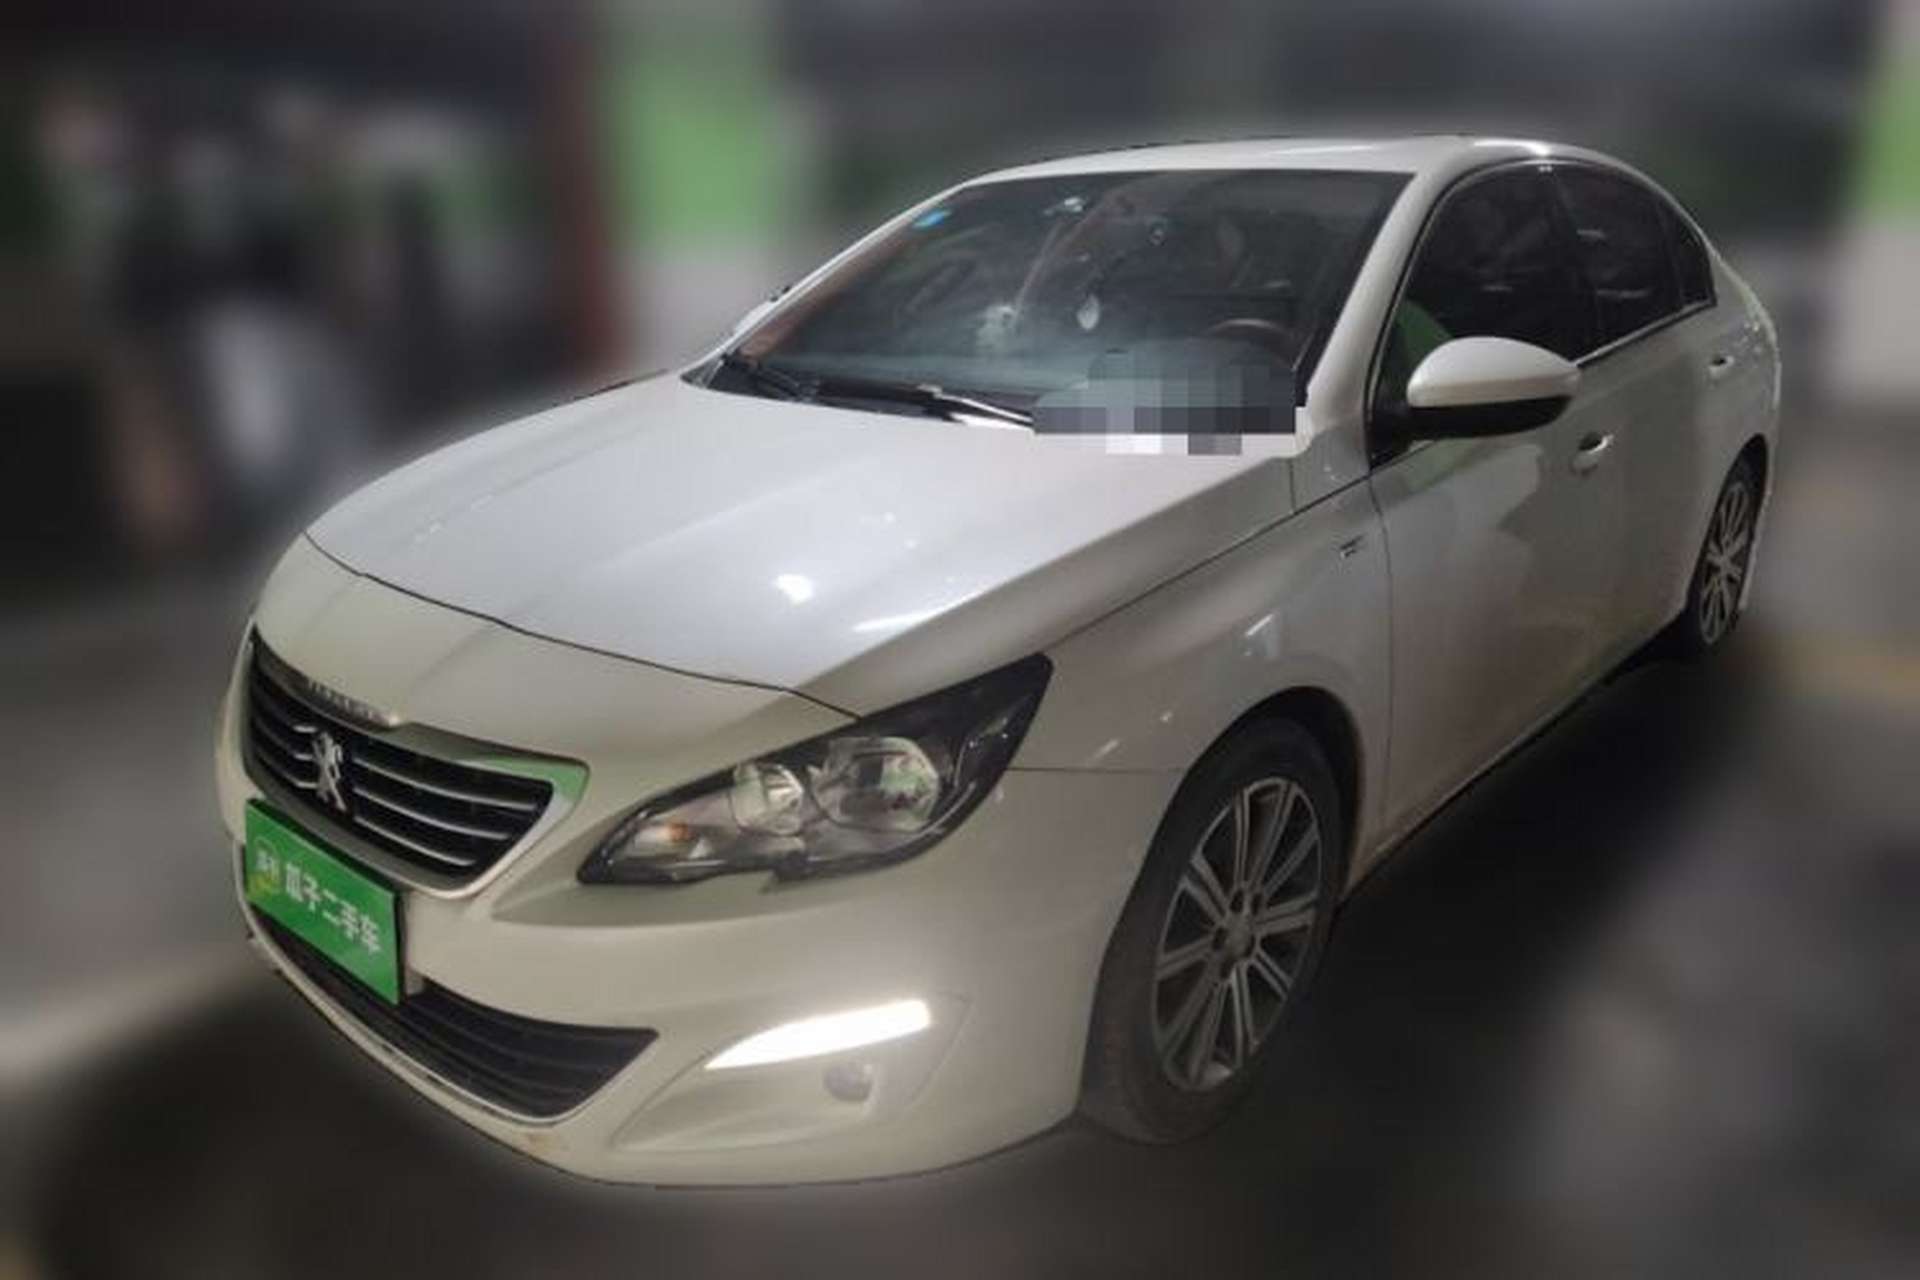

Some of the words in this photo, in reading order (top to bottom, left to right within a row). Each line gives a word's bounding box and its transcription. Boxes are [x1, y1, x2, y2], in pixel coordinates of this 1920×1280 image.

[285, 861, 380, 953] 瓜子二手车
